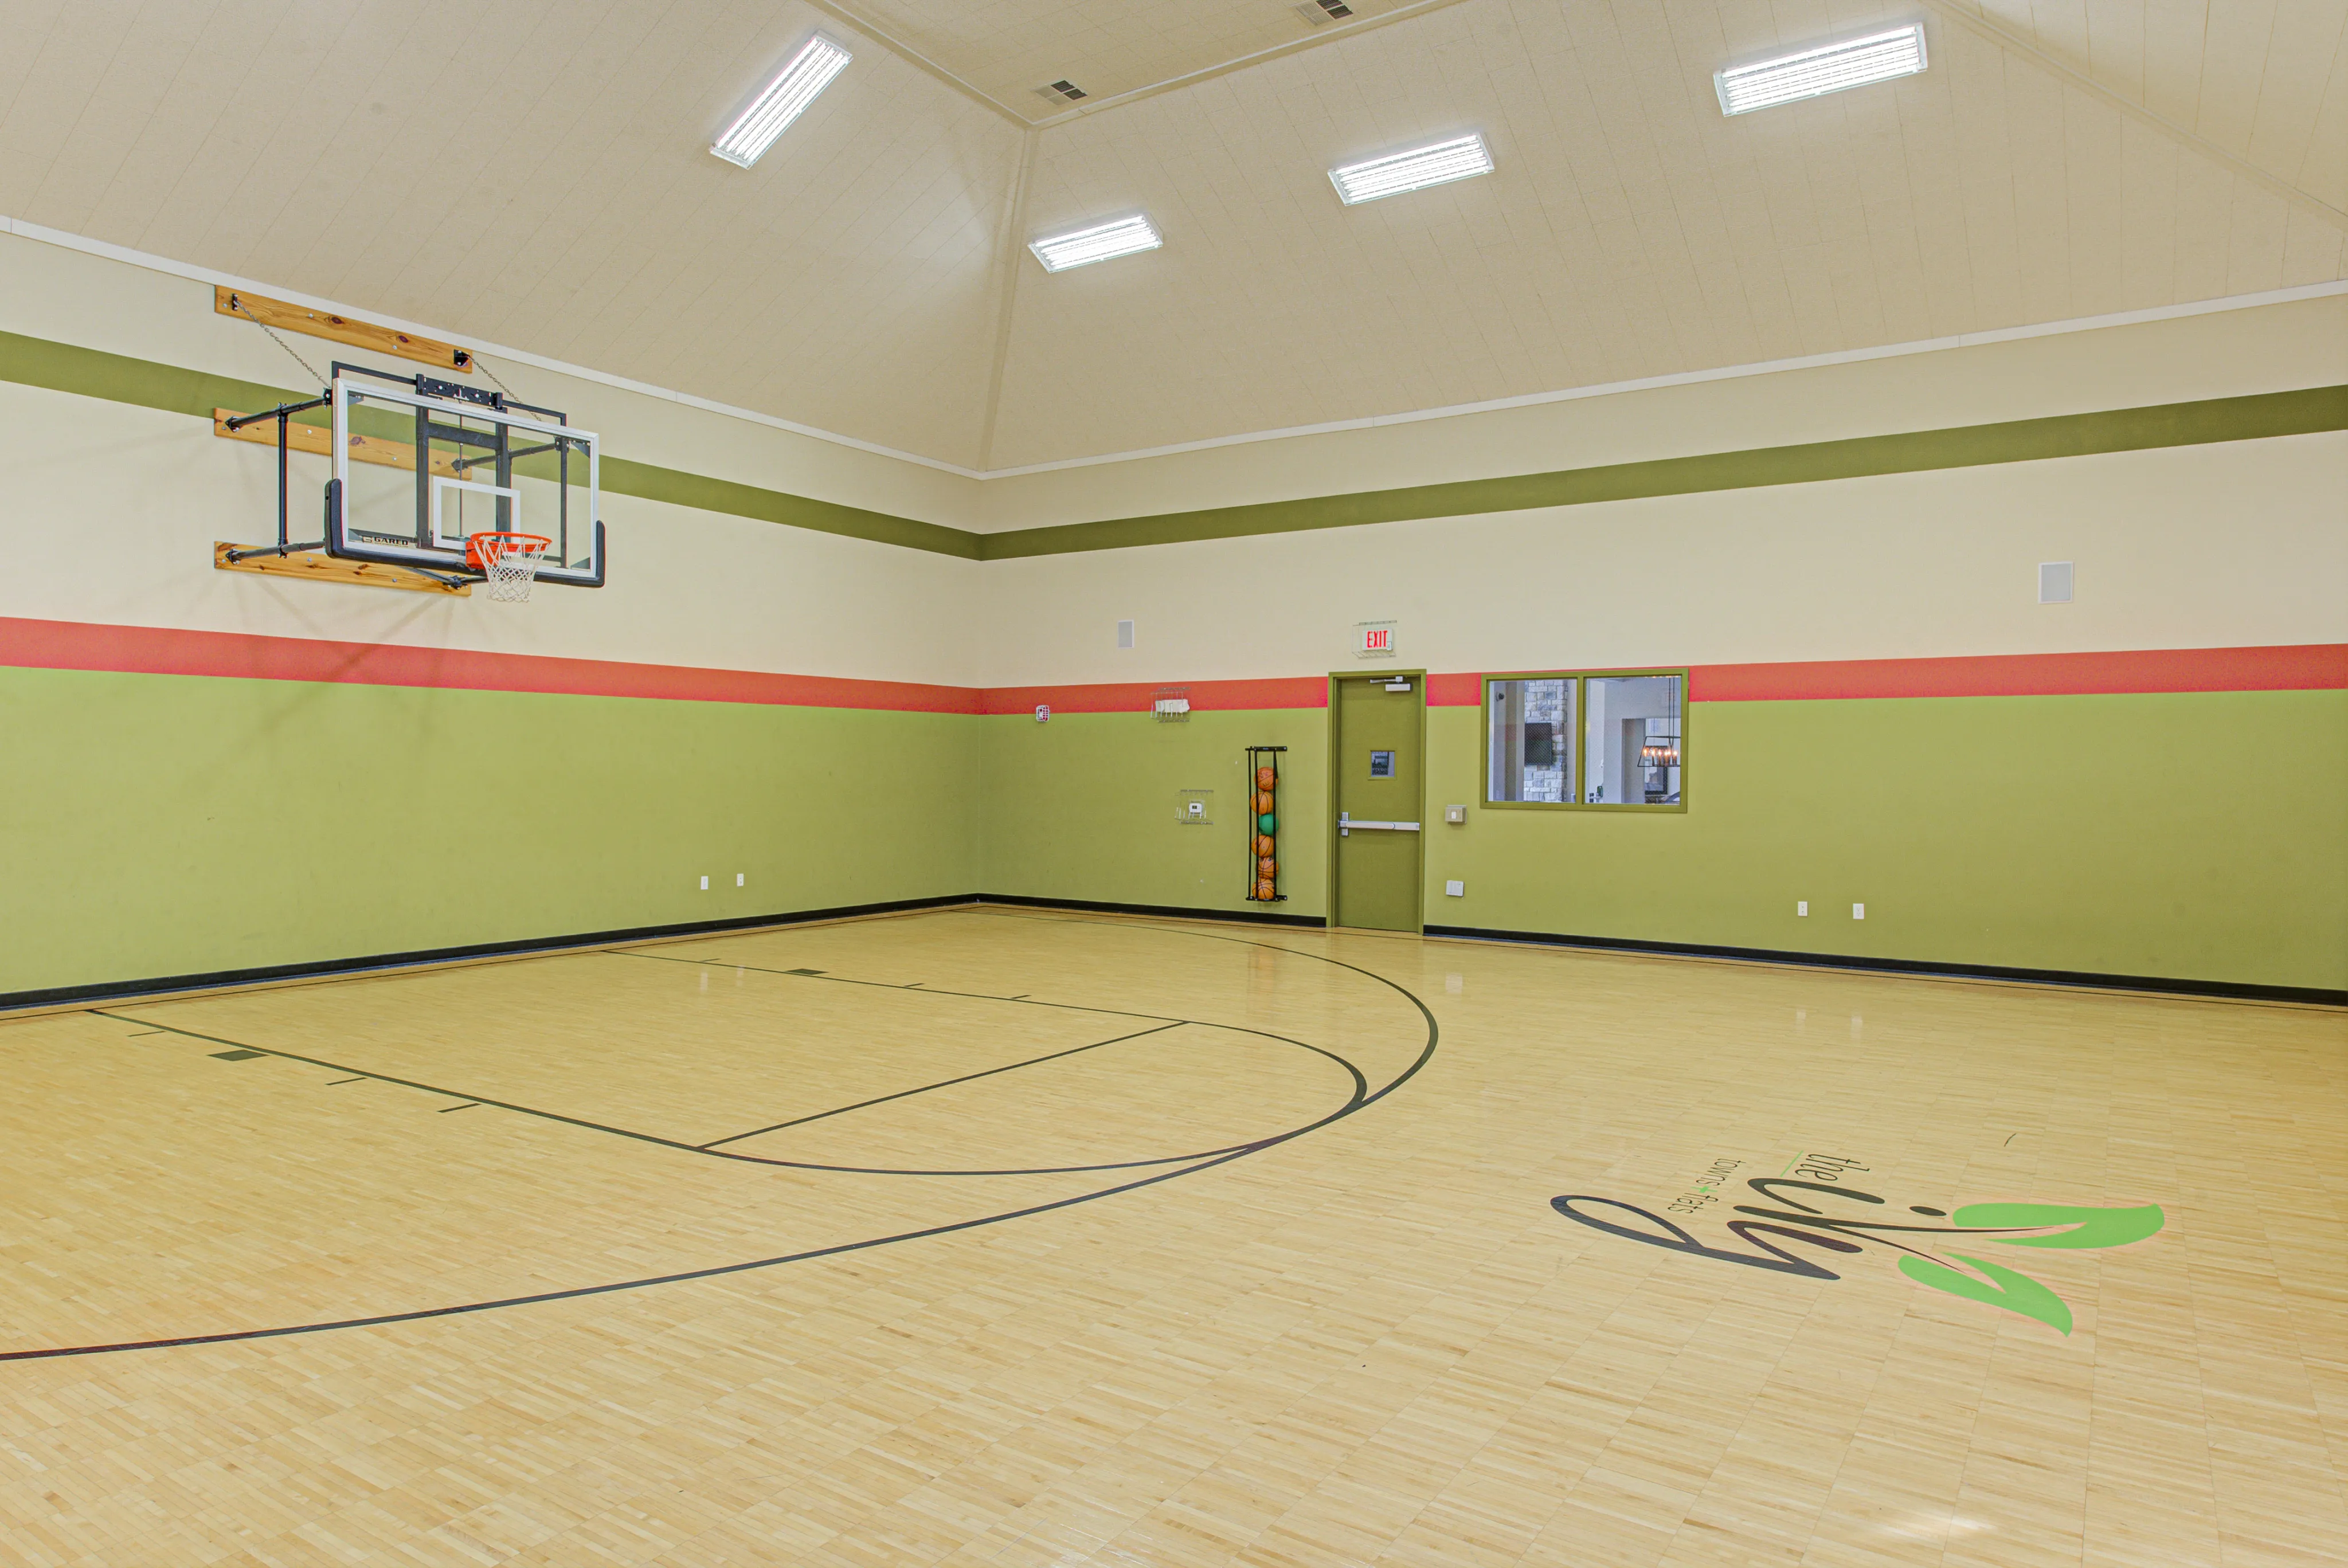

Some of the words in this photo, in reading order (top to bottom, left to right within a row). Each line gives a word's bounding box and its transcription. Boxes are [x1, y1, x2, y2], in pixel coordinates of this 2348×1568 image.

[374, 537, 409, 546] GARED
[1367, 630, 1388, 648] EXIT
[1795, 1154, 1870, 1181] the
[1549, 1177, 2057, 1281] ivy
